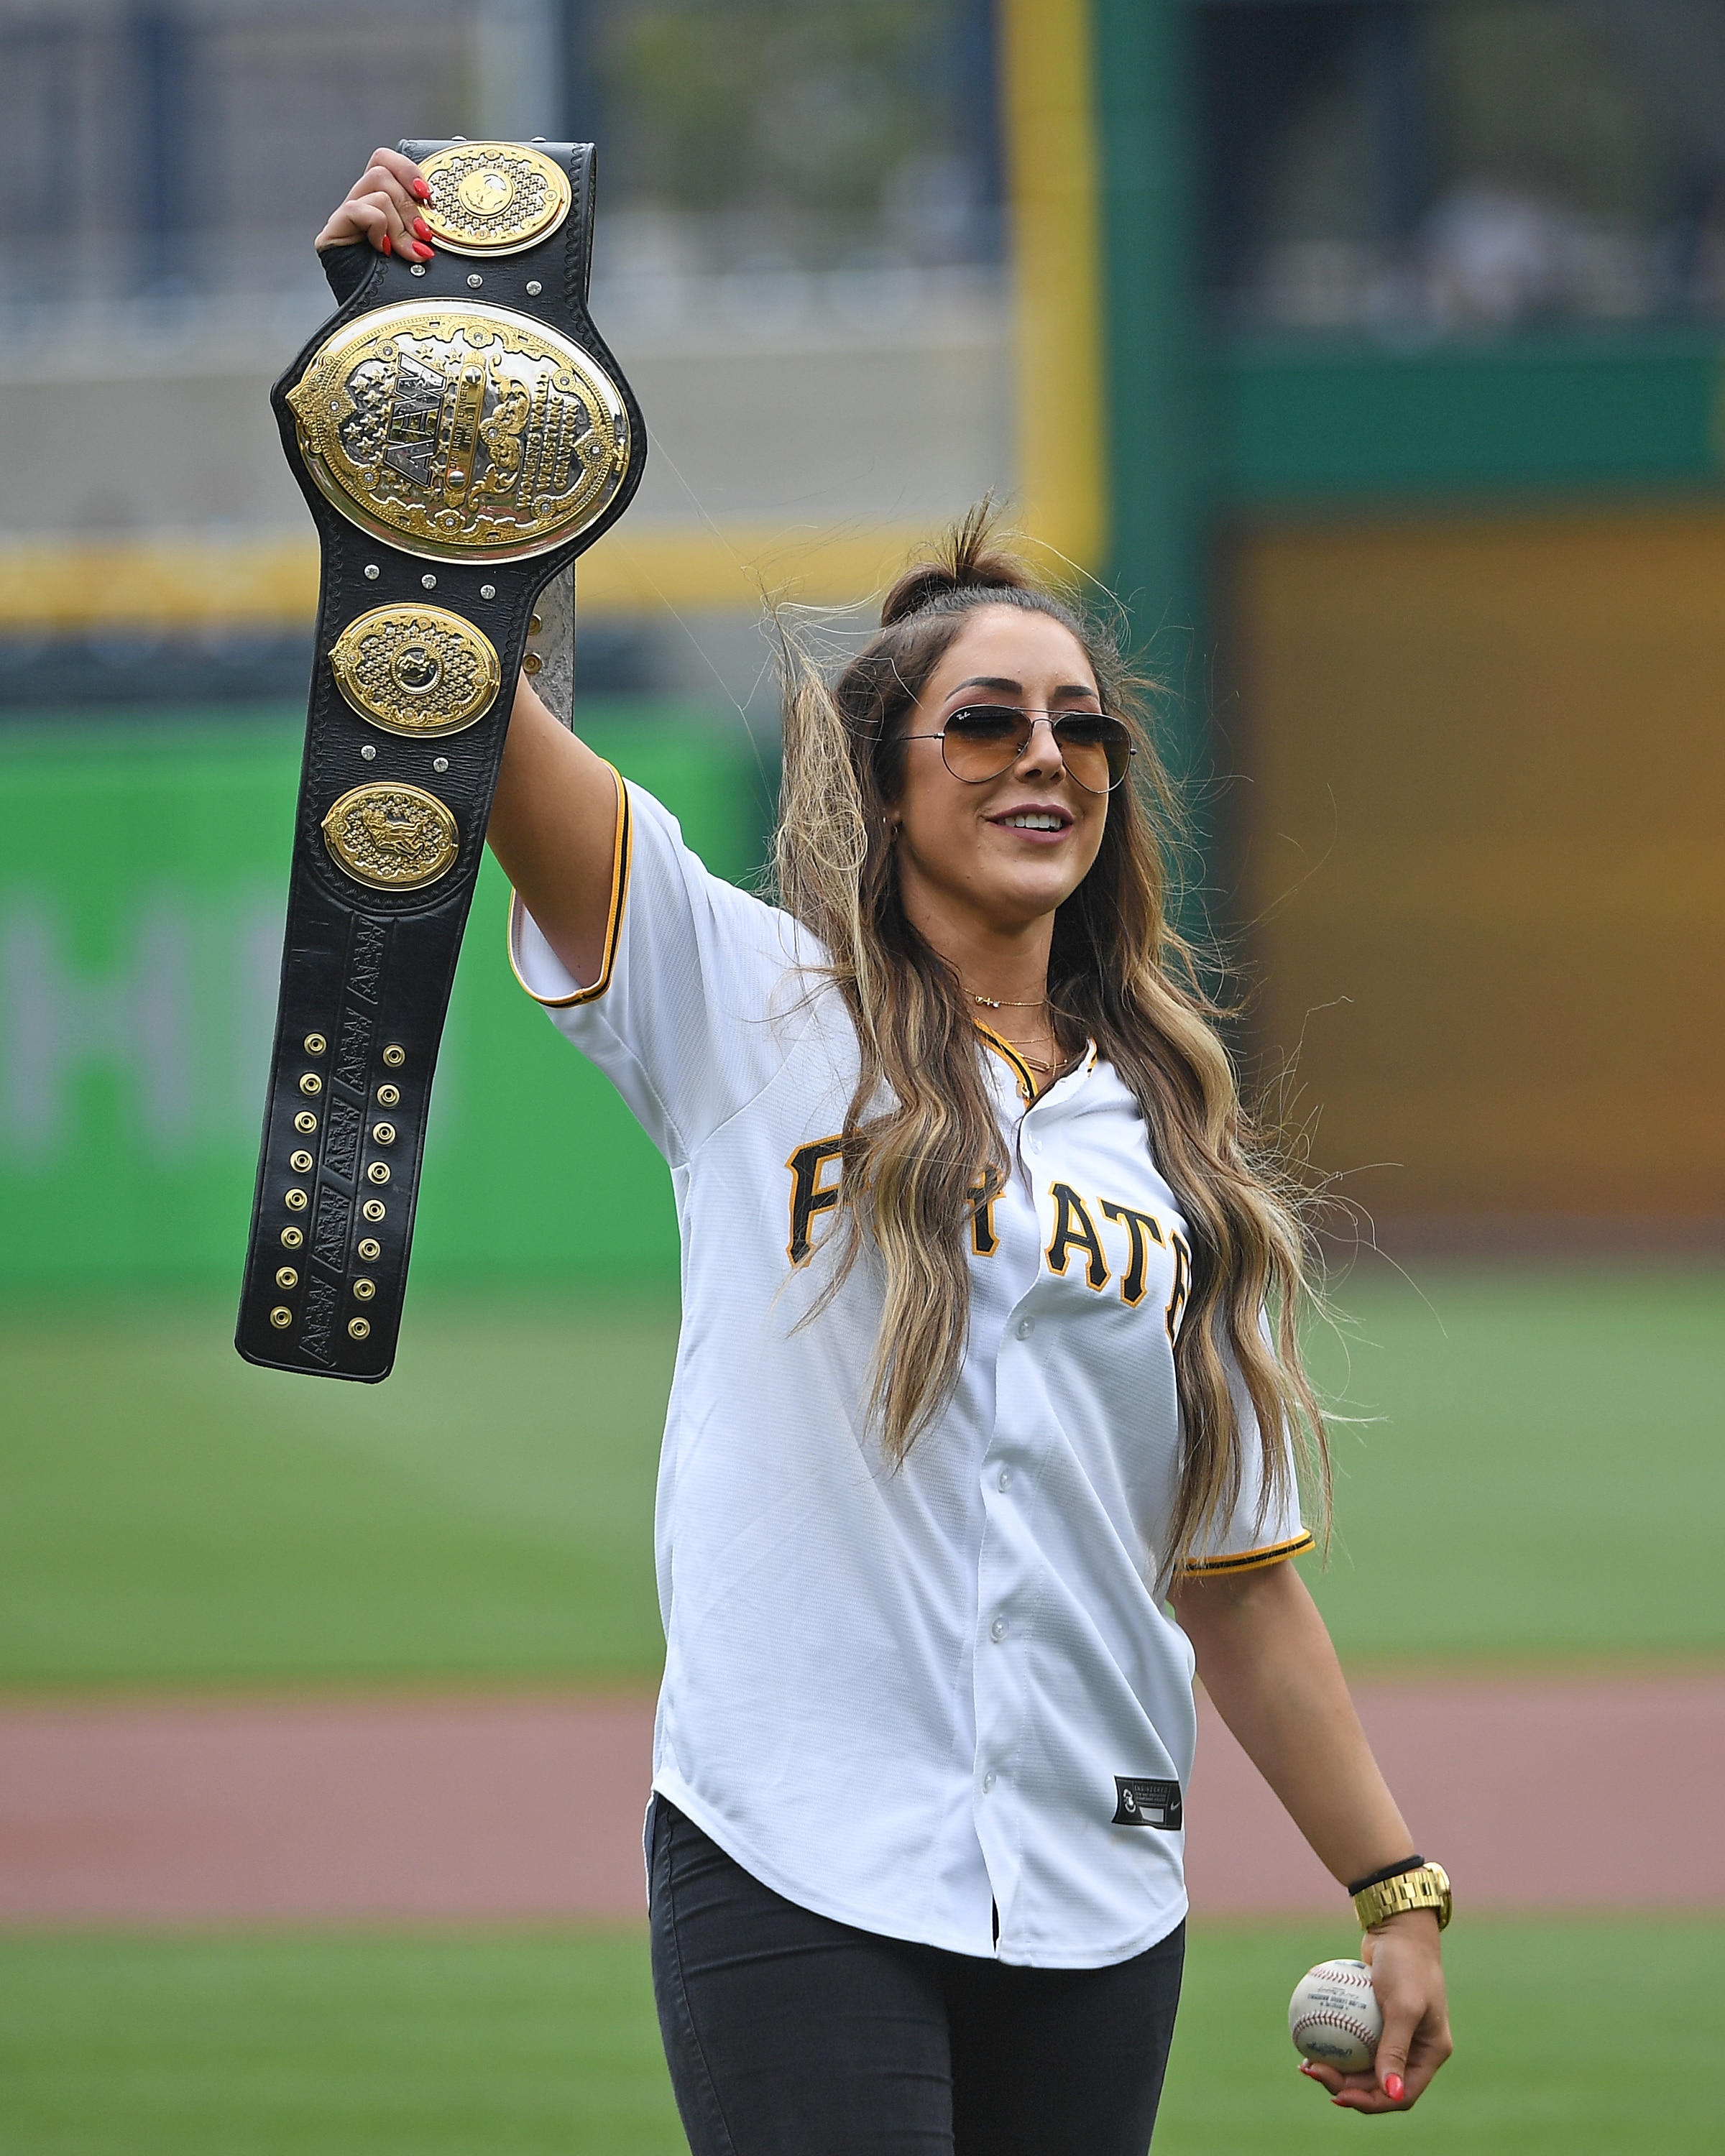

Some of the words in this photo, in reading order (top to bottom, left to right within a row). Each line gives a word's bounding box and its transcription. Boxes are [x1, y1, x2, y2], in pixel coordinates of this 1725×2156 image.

[384, 351, 447, 487] AEW
[457, 383, 470, 418] BAKER
[530, 370, 549, 431] WORLD
[537, 394, 564, 490] WRESTLING
[553, 402, 579, 489] CHAMPION
